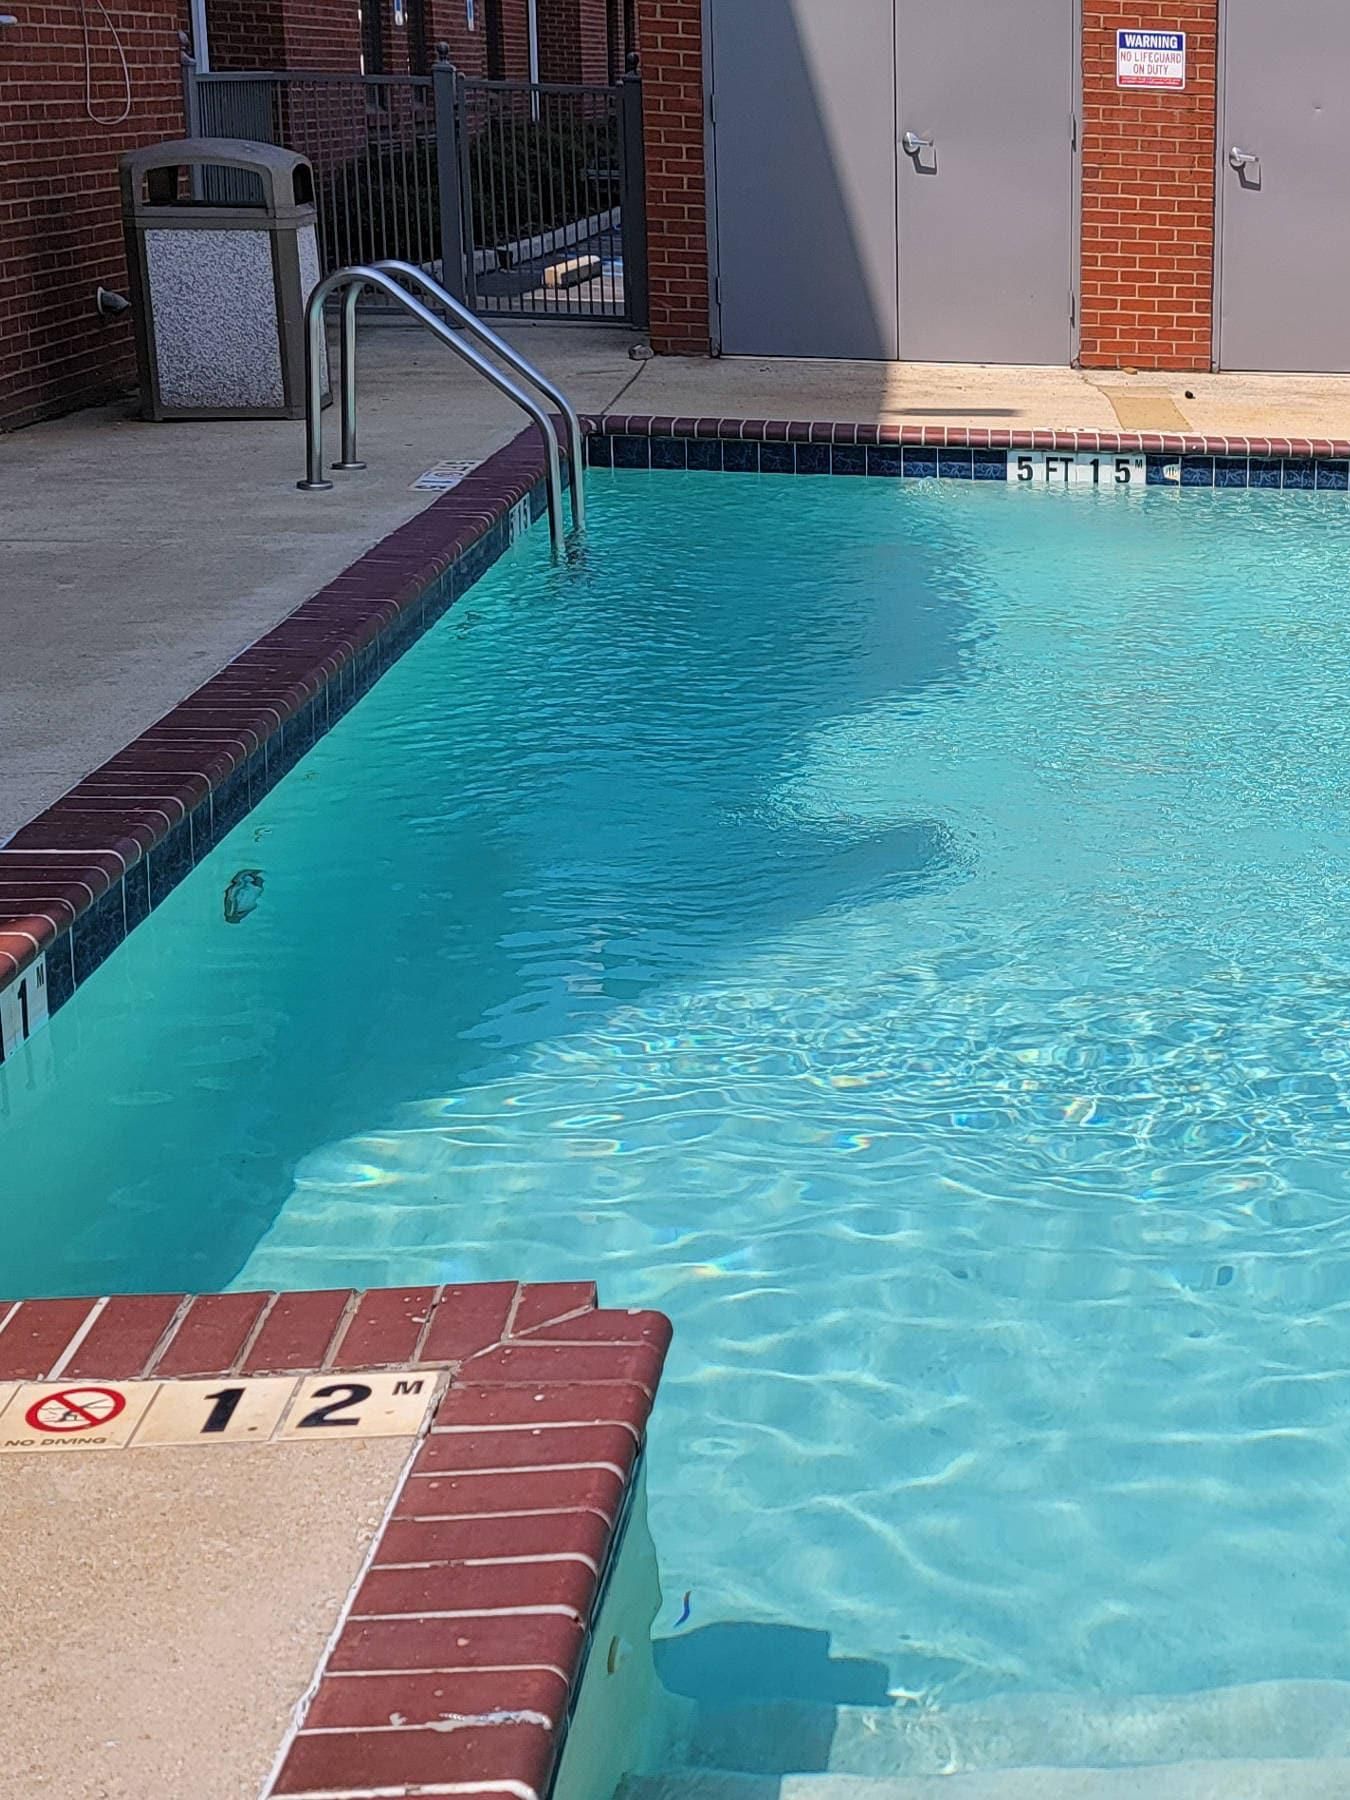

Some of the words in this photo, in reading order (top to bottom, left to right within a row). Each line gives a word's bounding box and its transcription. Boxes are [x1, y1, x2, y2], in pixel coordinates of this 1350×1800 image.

[1124, 34, 1178, 49] WARNING
[1120, 51, 1132, 62] NO
[1134, 51, 1181, 64] LIFEGUARD
[1133, 63, 1145, 75] ON
[1147, 64, 1169, 75] DUTY
[1046, 456, 1074, 482] FT
[5, 1439, 35, 1447] NO
[41, 1437, 107, 1446] DIVING
